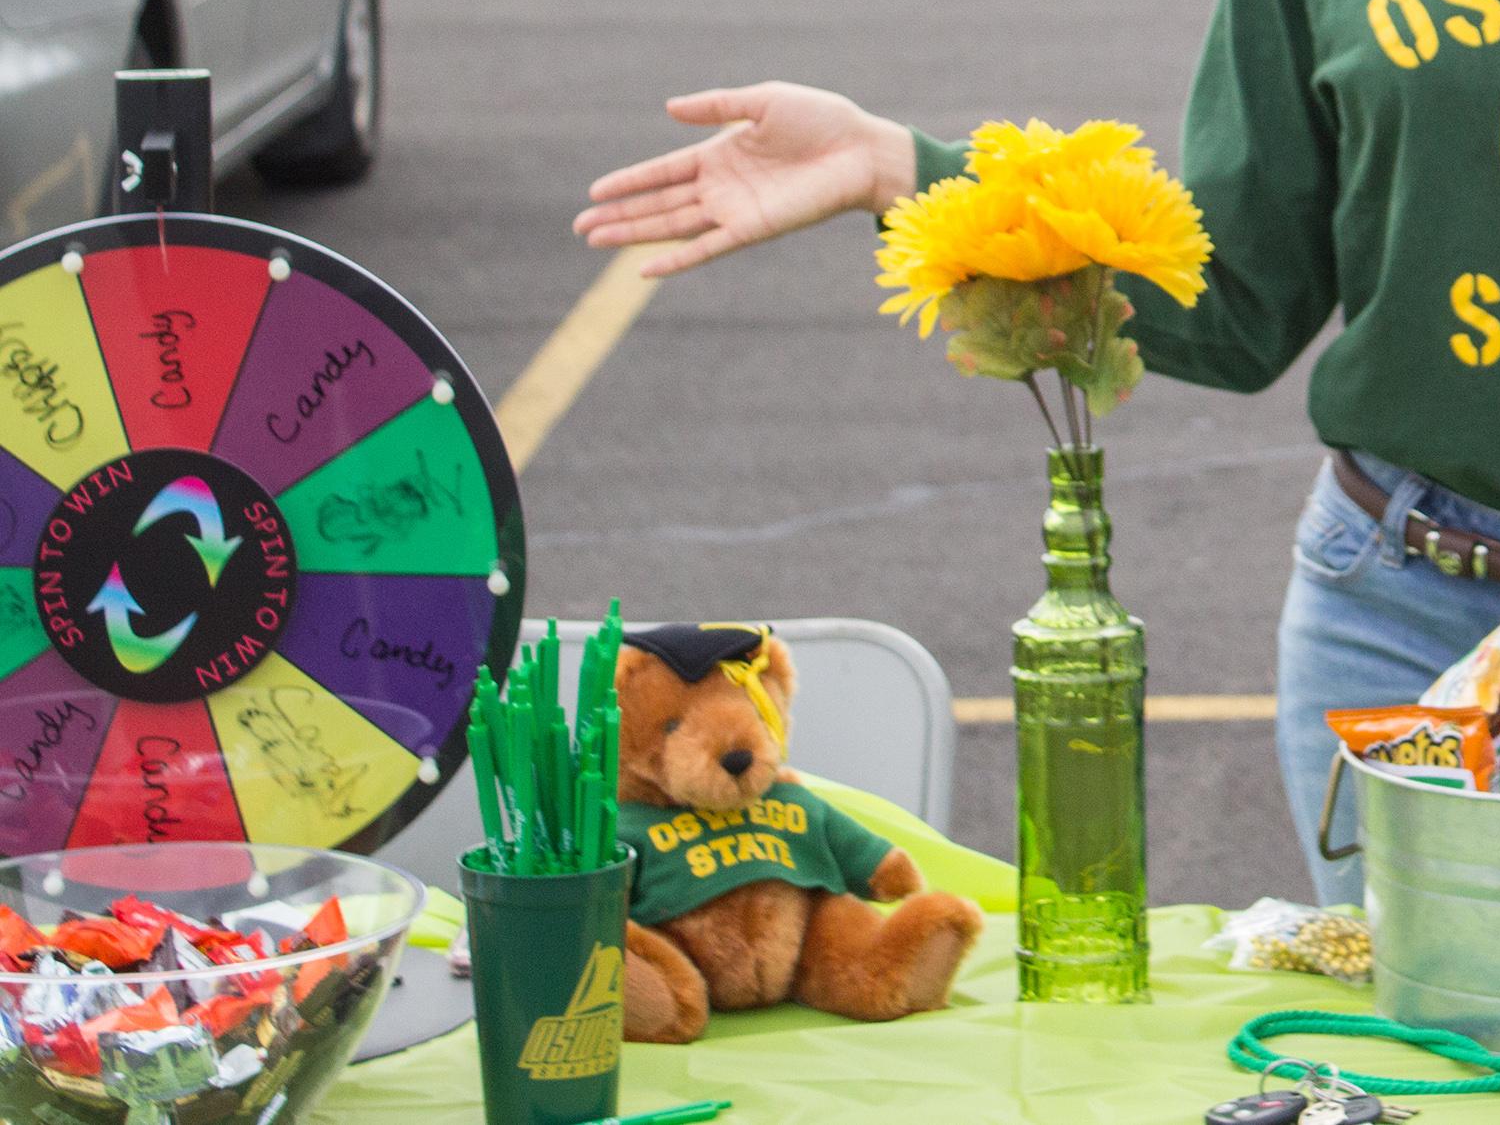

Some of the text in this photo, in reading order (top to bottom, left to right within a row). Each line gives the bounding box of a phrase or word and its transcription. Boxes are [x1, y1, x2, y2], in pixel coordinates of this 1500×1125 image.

[138, 309, 196, 409] Candy
[266, 338, 377, 444] Candy
[38, 459, 133, 649] SPIN TO WIN
[194, 500, 289, 689] SPIN TO WIN
[339, 617, 457, 688] Candy
[685, 832, 797, 879] STATE
